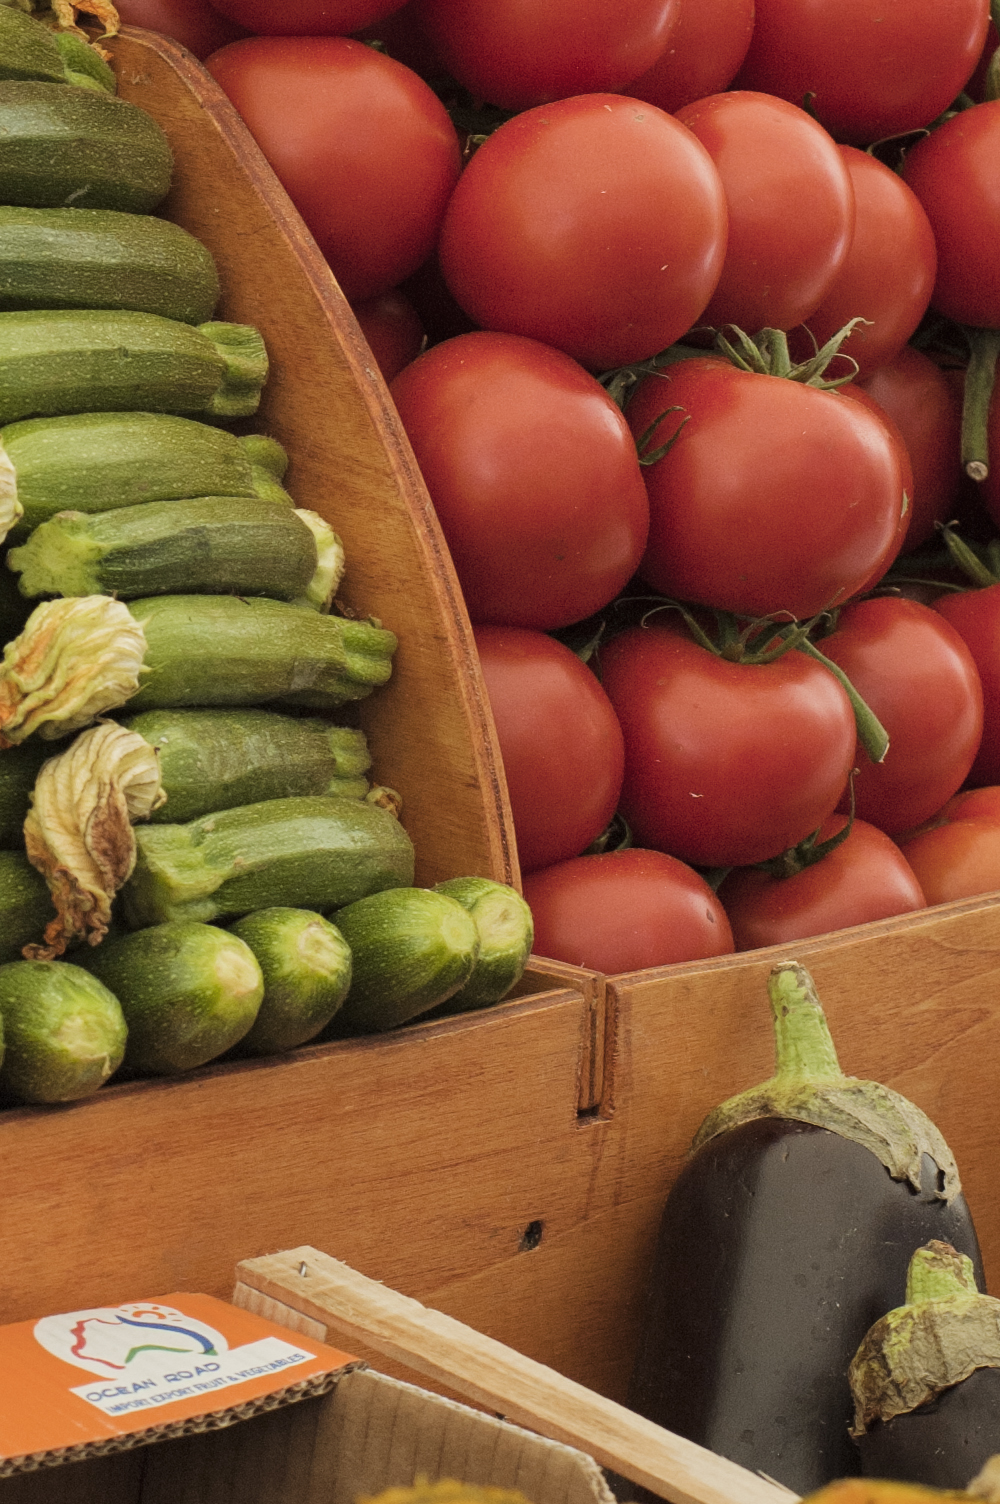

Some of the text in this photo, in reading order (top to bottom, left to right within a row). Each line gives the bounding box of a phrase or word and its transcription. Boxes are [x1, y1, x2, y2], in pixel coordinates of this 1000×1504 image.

[85, 1361, 221, 1403] OCEAN ROAD
[106, 1396, 150, 1414] IMPORT
[149, 1386, 195, 1404] EXPORT
[192, 1378, 227, 1393] FRUIT
[235, 1352, 306, 1378] VEGETABLES
